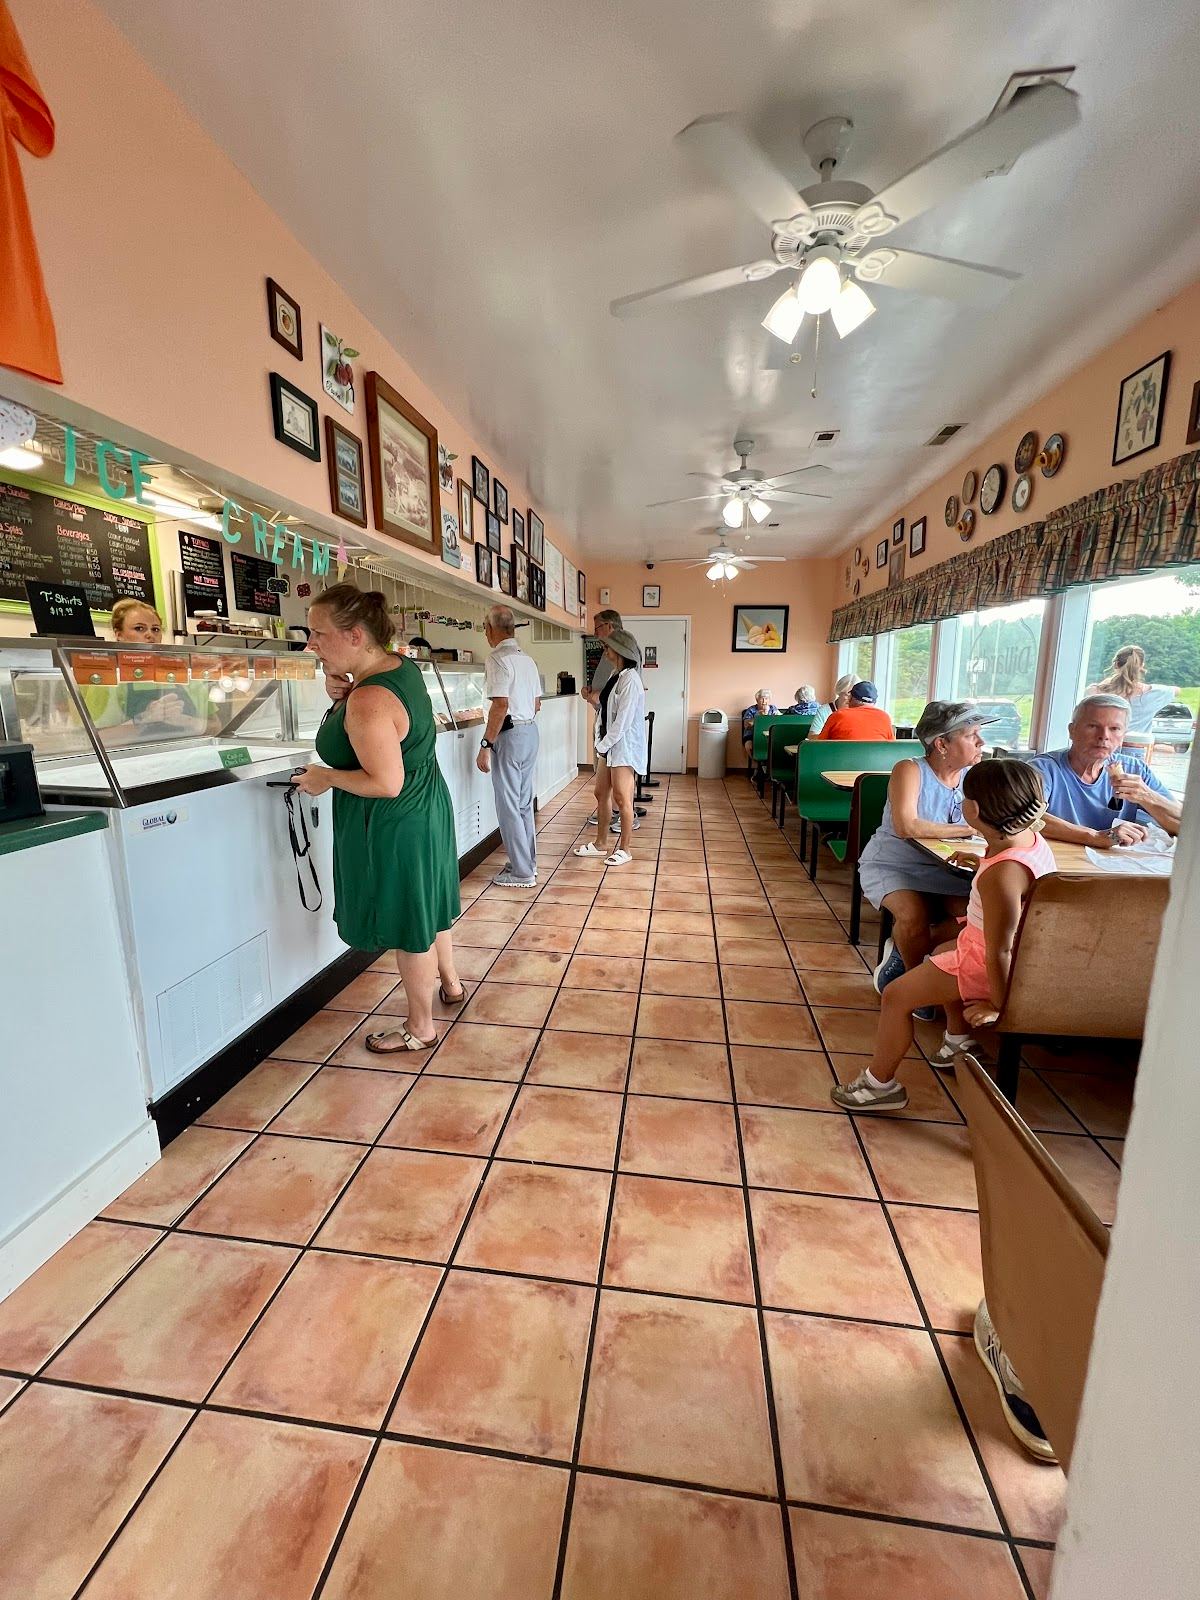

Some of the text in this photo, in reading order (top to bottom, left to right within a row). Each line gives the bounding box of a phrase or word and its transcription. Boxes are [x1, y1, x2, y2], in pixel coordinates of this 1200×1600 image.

[222, 499, 330, 576] CREAM
[39, 591, 83, 606] T-Shirts
[142, 815, 164, 826] GLOBAL
